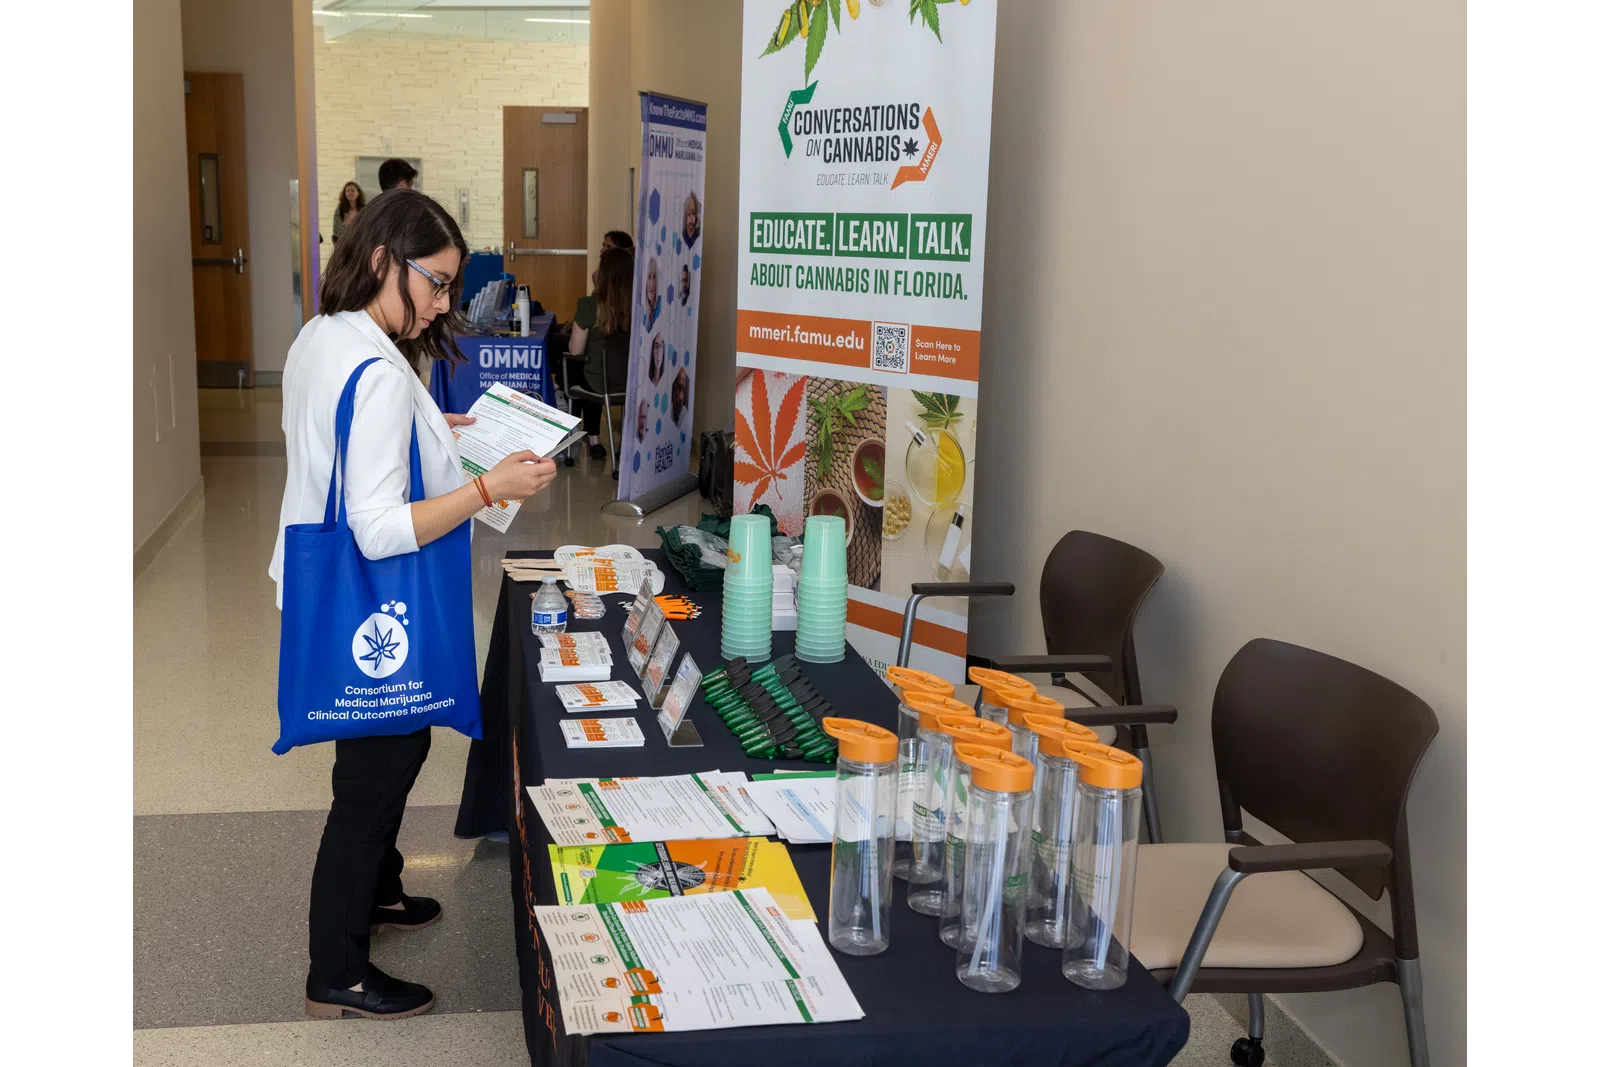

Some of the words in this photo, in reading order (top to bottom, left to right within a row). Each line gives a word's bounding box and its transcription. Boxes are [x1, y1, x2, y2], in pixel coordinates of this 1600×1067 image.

[782, 97, 794, 124] FAMU
[794, 102, 920, 136] CONVERSATIONS
[649, 134, 674, 159] OMMU
[806, 139, 822, 156] ON
[823, 135, 900, 164] CANNABIS
[920, 142, 939, 174] MMERI
[816, 173, 846, 186] EDUCATE.
[848, 173, 871, 186] LEARN.
[753, 219, 830, 250] EDUCATE.
[838, 220, 904, 253] LEARN.
[915, 221, 969, 256] TALK.
[750, 262, 792, 288] ABOUT
[795, 264, 870, 293] CANNABIS
[874, 269, 889, 295] IN
[894, 270, 968, 300] FLORIDA.
[748, 324, 865, 350] mmeri.famu.edu
[915, 339, 934, 349] Scan
[936, 340, 952, 351] Here
[953, 342, 961, 352] to
[479, 348, 543, 369] OMMU
[914, 351, 937, 362] Learn
[938, 354, 957, 364] More
[479, 372, 500, 380] Office
[508, 372, 541, 381] MEDICAL
[480, 381, 528, 389] MARJUANA
[528, 381, 541, 390] Use
[655, 440, 673, 460] Florida
[654, 454, 673, 475] HEALTH
[344, 683, 407, 696] Consortium
[408, 680, 424, 690] for
[307, 710, 350, 721] Clinical
[352, 706, 408, 720] Outcomes
[410, 697, 456, 715] Research
[335, 697, 379, 708] Medical
[379, 690, 432, 707] Marijuana
